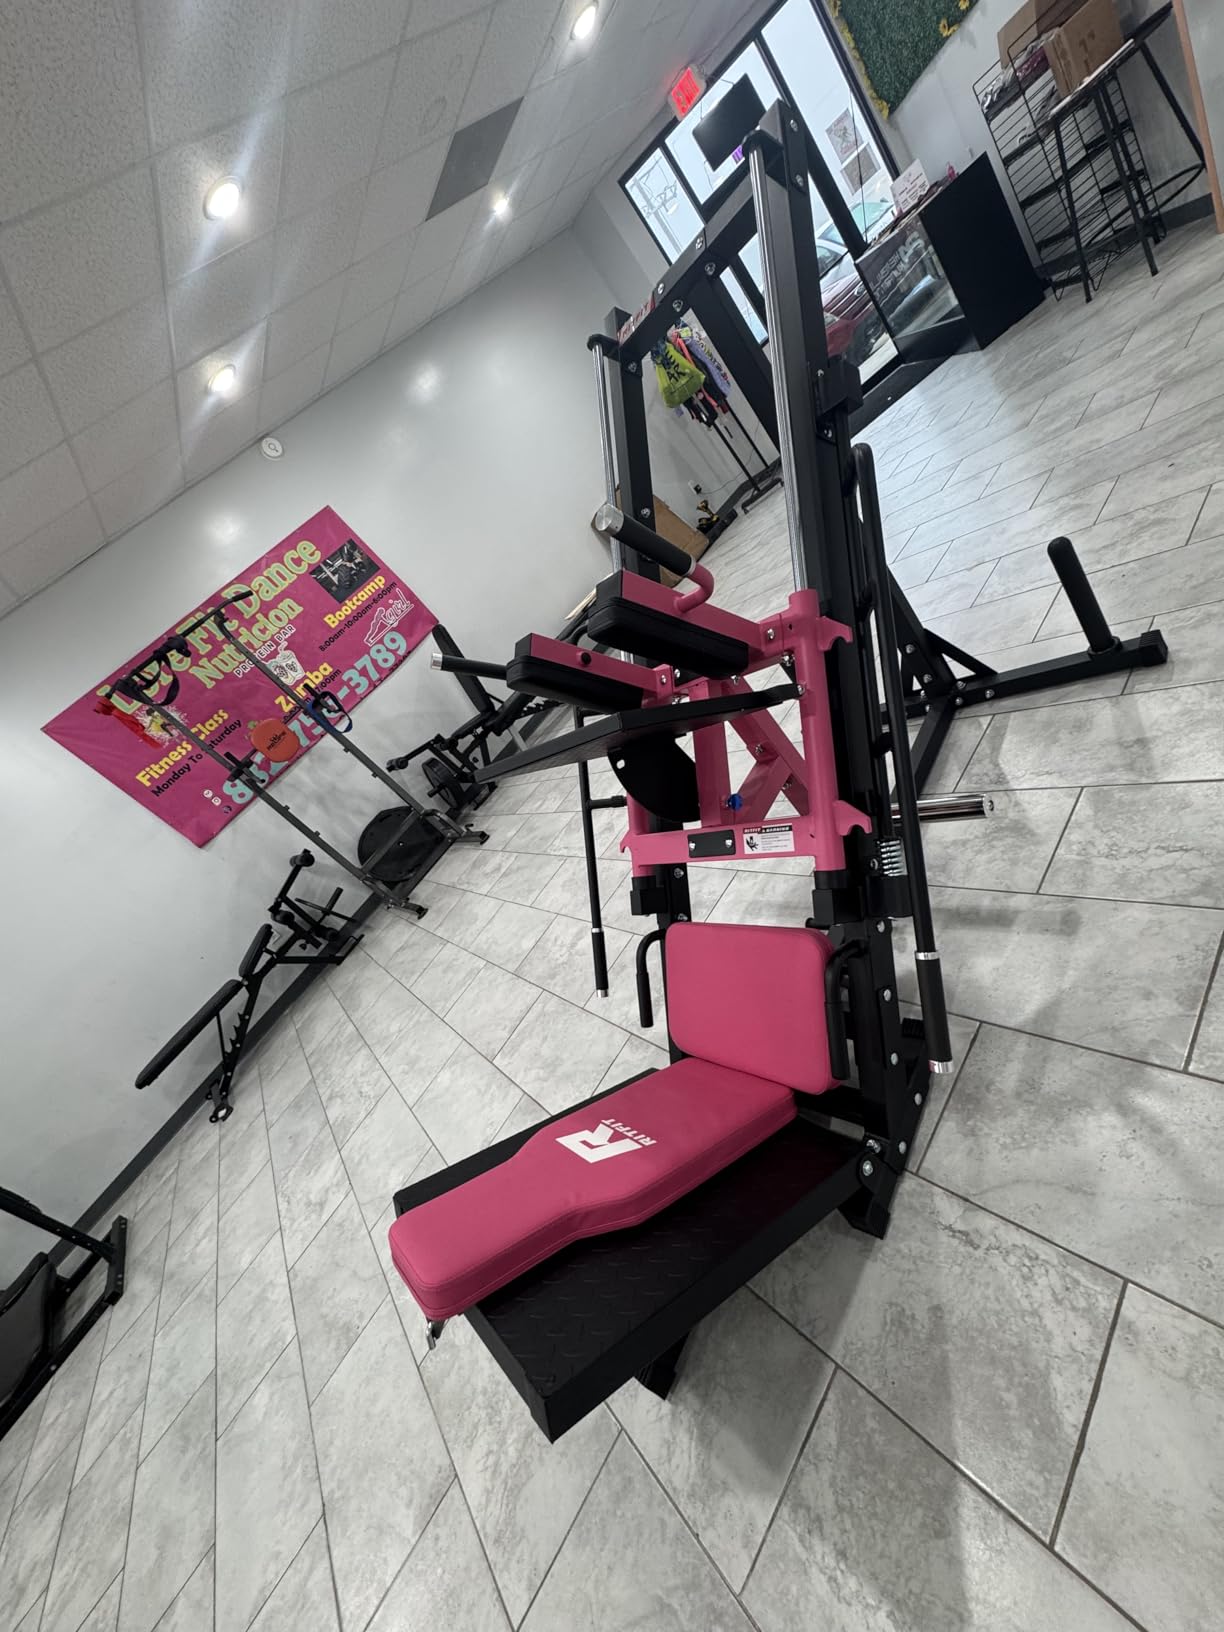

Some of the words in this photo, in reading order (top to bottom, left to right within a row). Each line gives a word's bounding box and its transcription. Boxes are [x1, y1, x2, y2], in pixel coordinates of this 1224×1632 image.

[221, 541, 321, 619] Dance
[324, 575, 386, 629] Bootcamp
[189, 598, 303, 688] Nuticion
[233, 641, 277, 678] PROEIN
[274, 624, 296, 642] BAR
[135, 741, 193, 787] Fitness
[151, 763, 191, 797] Monday
[188, 753, 203, 763] To
[201, 720, 242, 754] aturday
[601, 1118, 657, 1146] RITFIT
